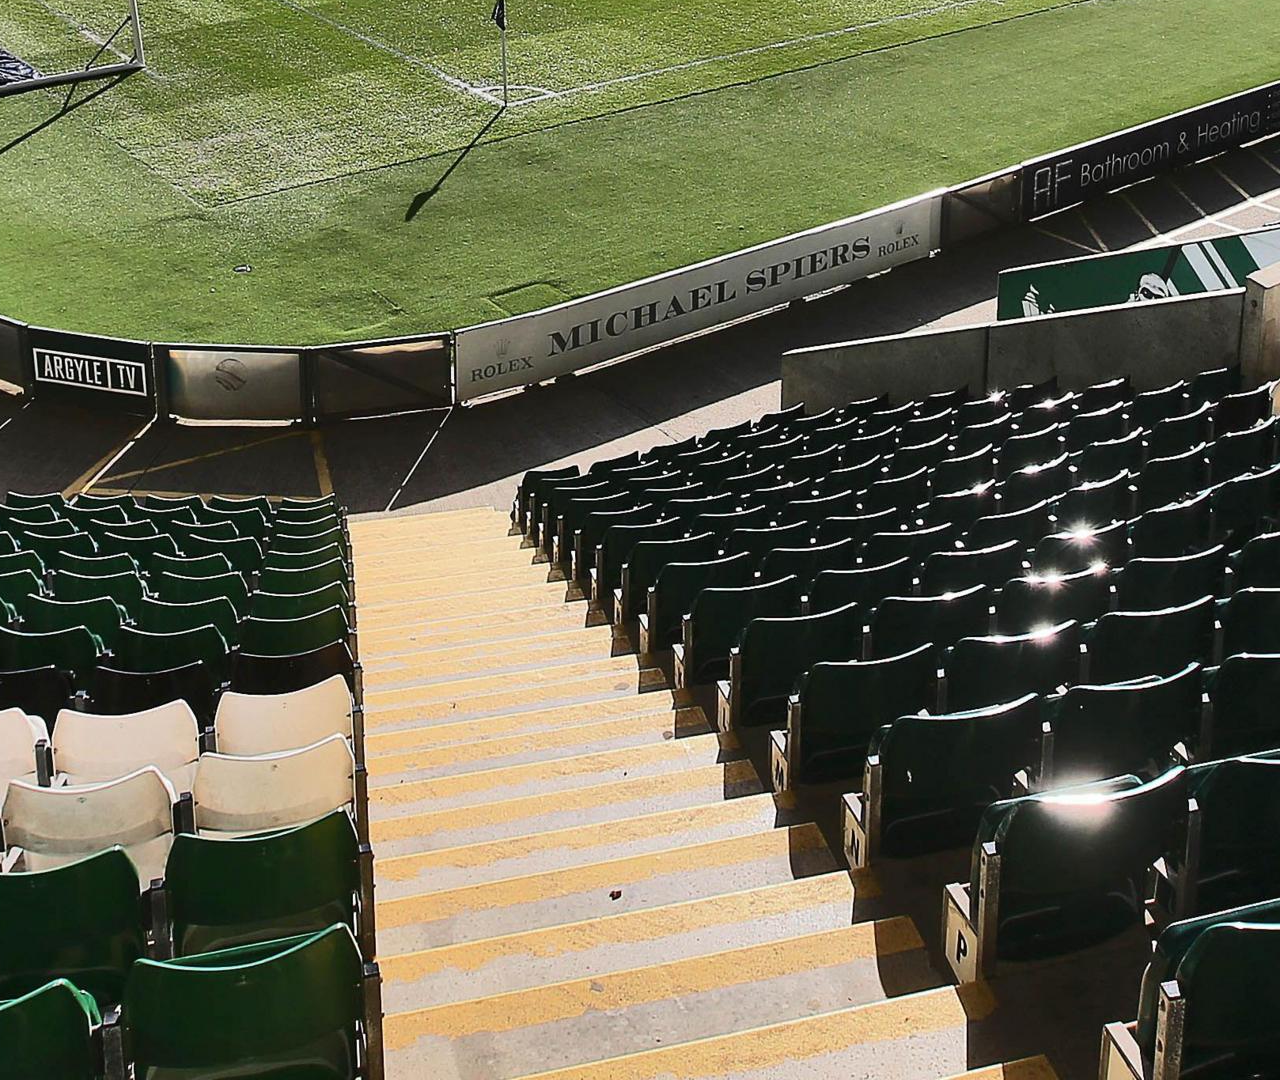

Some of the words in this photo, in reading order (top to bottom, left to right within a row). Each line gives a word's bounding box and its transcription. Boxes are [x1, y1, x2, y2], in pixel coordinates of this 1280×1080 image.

[1033, 158, 1073, 206] AF
[1080, 141, 1169, 188] Bathroom
[1176, 131, 1190, 155] &
[1197, 110, 1261, 147] Heating
[877, 234, 920, 258] ROLEX
[546, 279, 737, 358] MICHAEL
[744, 235, 871, 295] SPIERS
[43, 354, 102, 386] ARGYLE
[116, 364, 136, 390] TV
[470, 355, 535, 383] ROLEX
[956, 928, 968, 964] P
